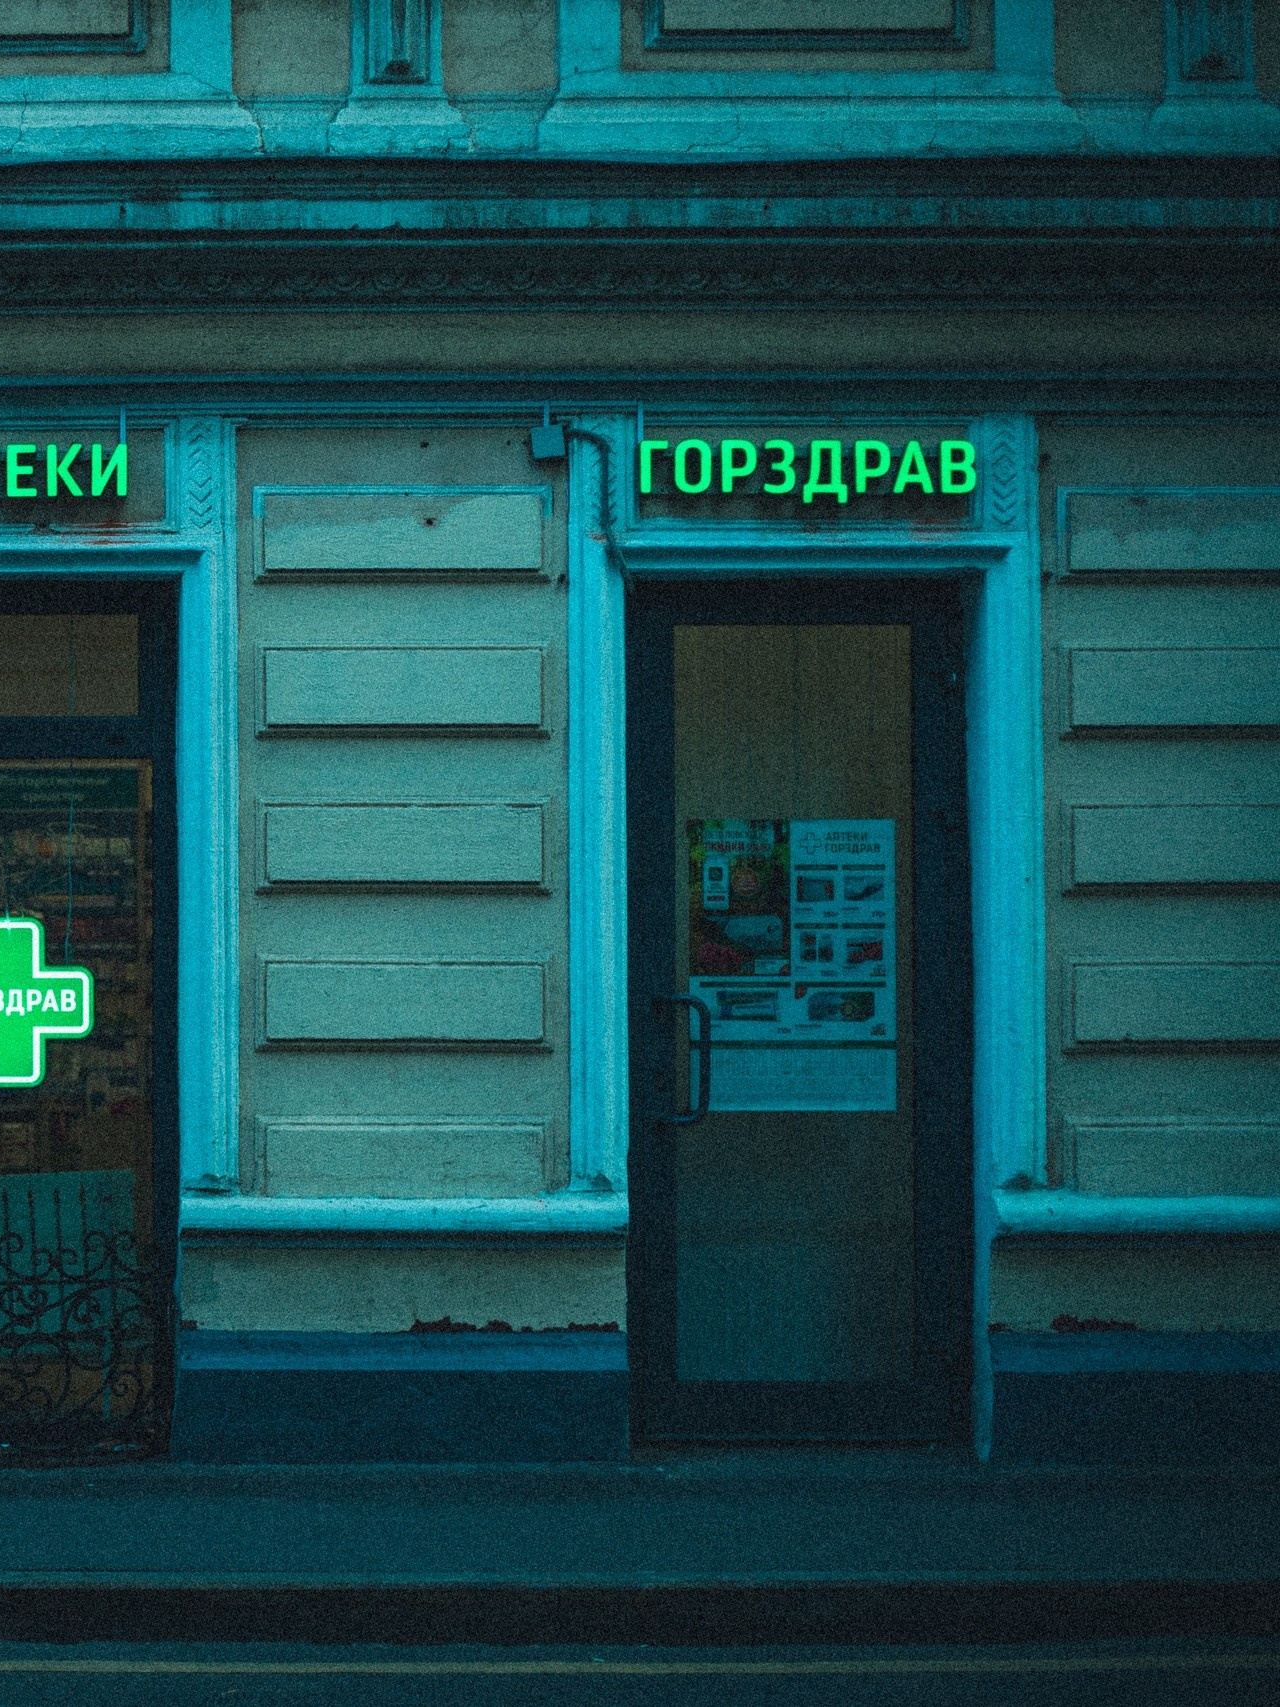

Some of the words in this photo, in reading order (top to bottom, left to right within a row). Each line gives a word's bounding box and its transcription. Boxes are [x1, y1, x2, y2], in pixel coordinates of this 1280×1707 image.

[639, 439, 977, 503] ГОРЗДРАВ
[825, 831, 868, 842] АПТЕКИ
[824, 843, 881, 855] ГОРЗДРАВ
